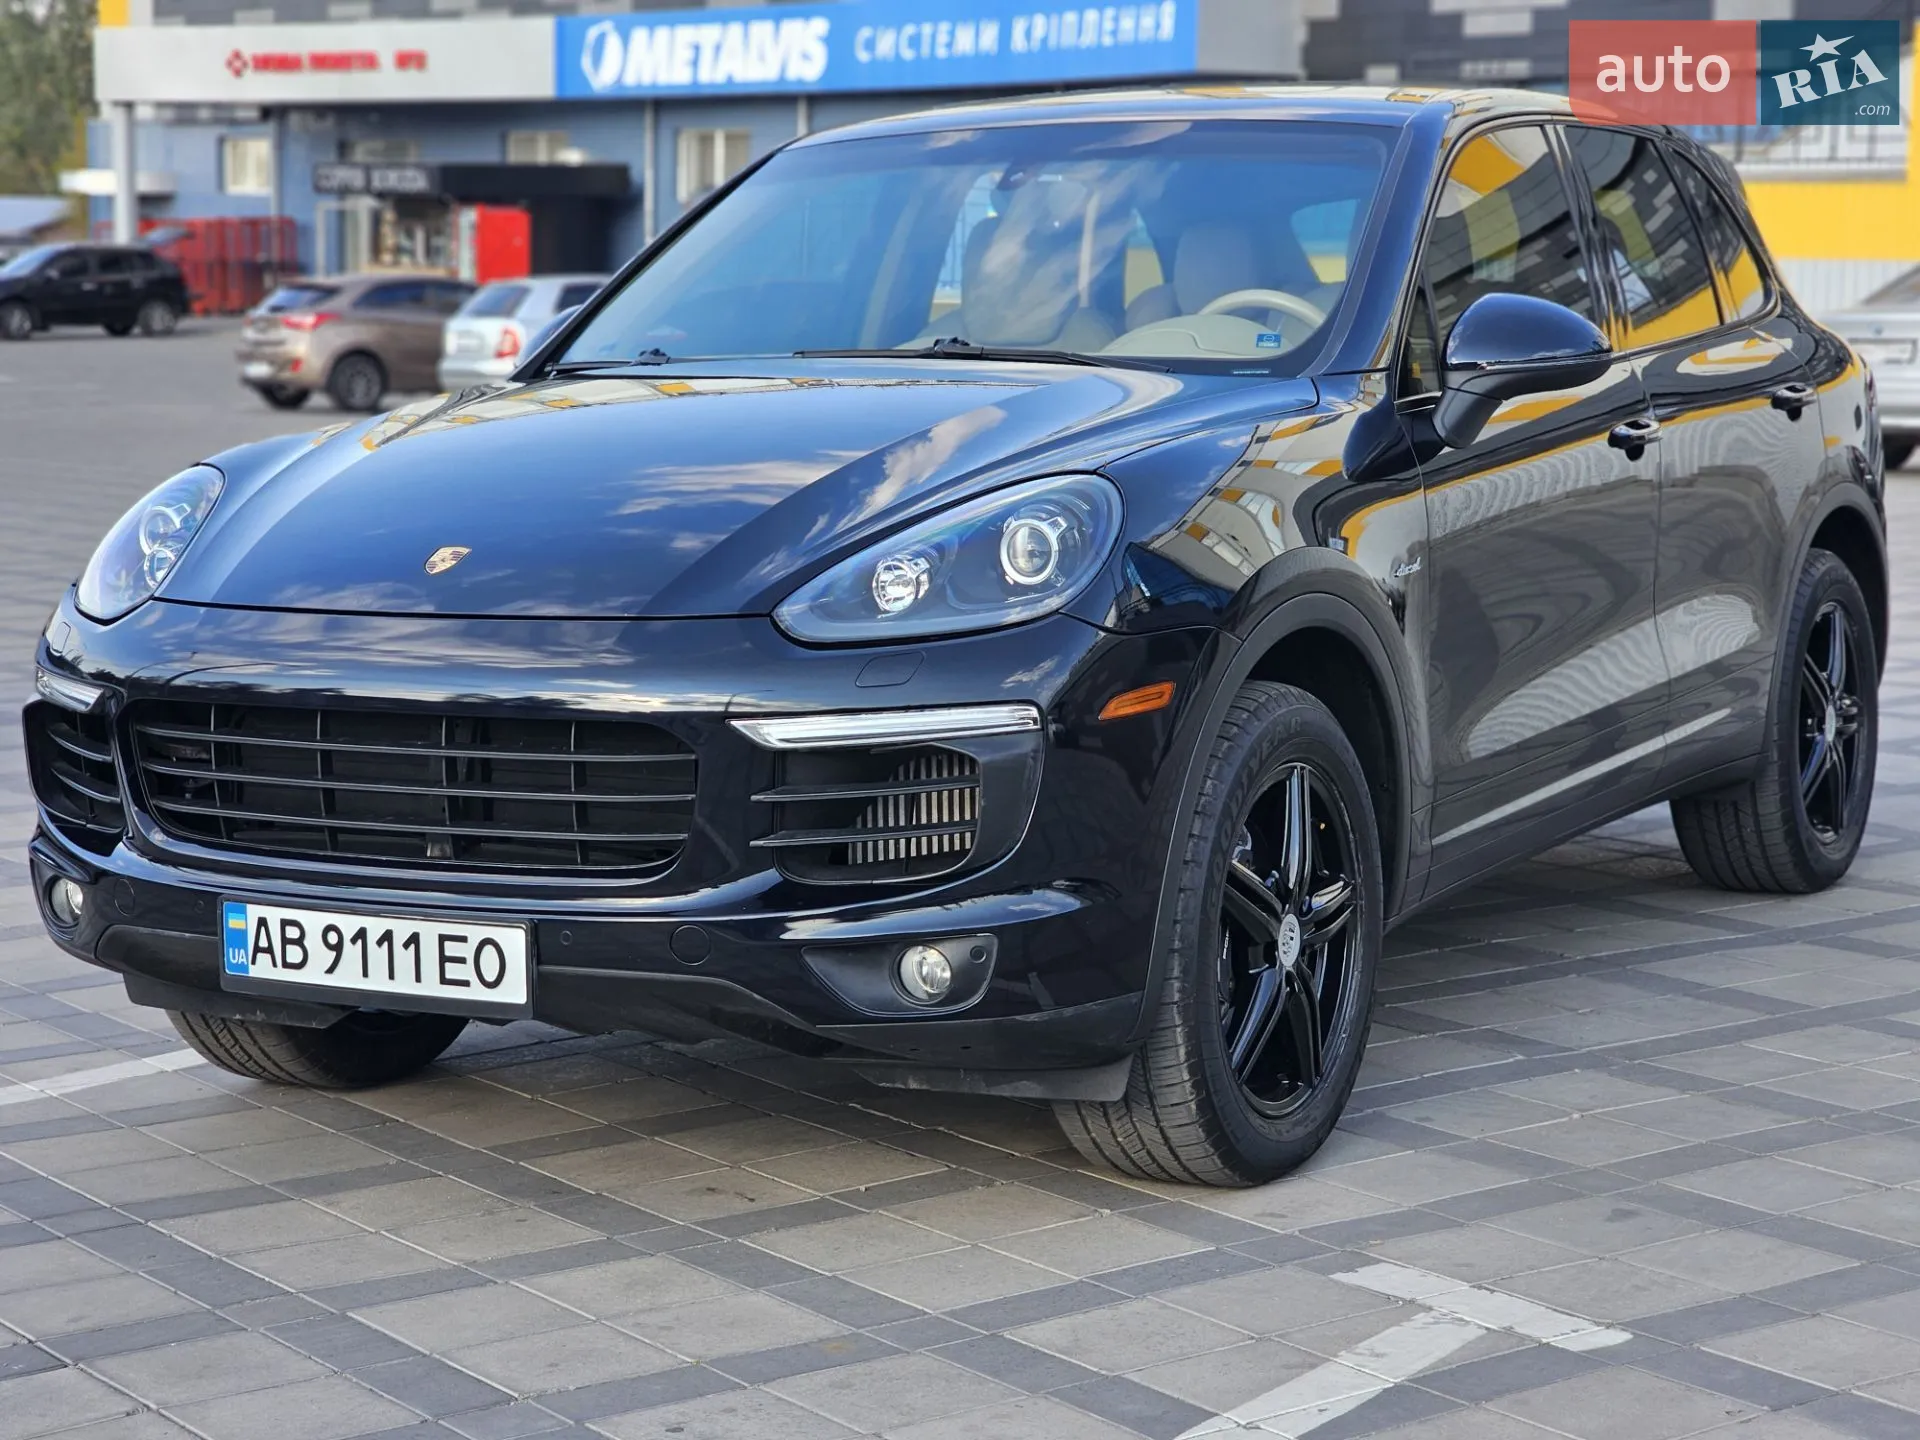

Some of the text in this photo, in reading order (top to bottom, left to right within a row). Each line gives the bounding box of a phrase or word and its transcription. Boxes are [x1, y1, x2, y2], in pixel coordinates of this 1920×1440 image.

[854, 0, 1177, 63] СИСТЕМИ КРІПЛЕННЯ
[229, 947, 247, 966] UA
[250, 916, 507, 990] AB 9111 EO
